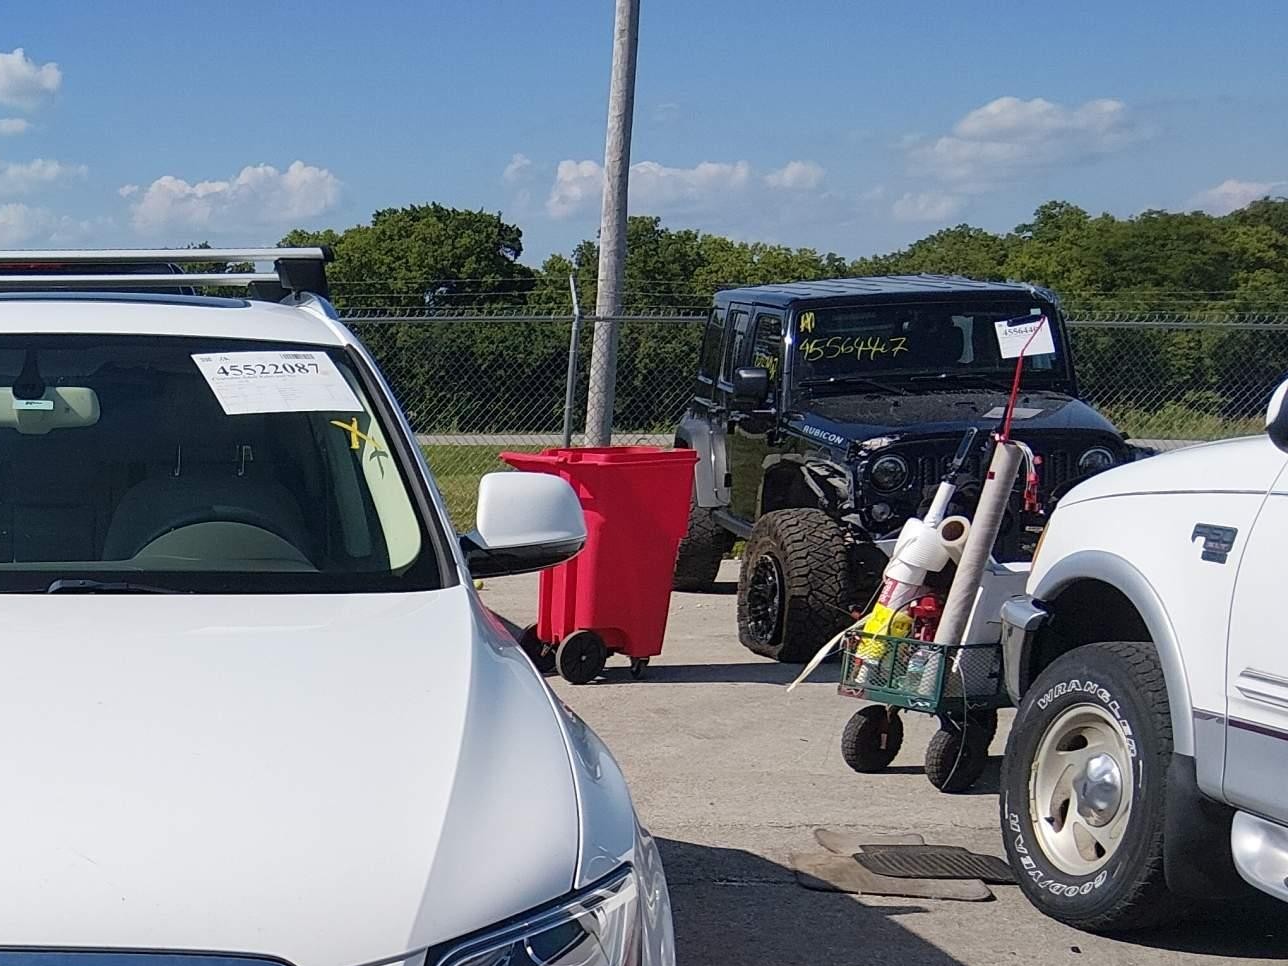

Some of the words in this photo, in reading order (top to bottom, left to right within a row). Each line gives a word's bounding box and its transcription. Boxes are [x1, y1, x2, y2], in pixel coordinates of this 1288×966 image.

[216, 362, 319, 377] 45522087
[802, 424, 844, 445] RUBICON
[1036, 679, 1137, 758] WRANGLER
[1008, 812, 1108, 897] GOODYEAR
